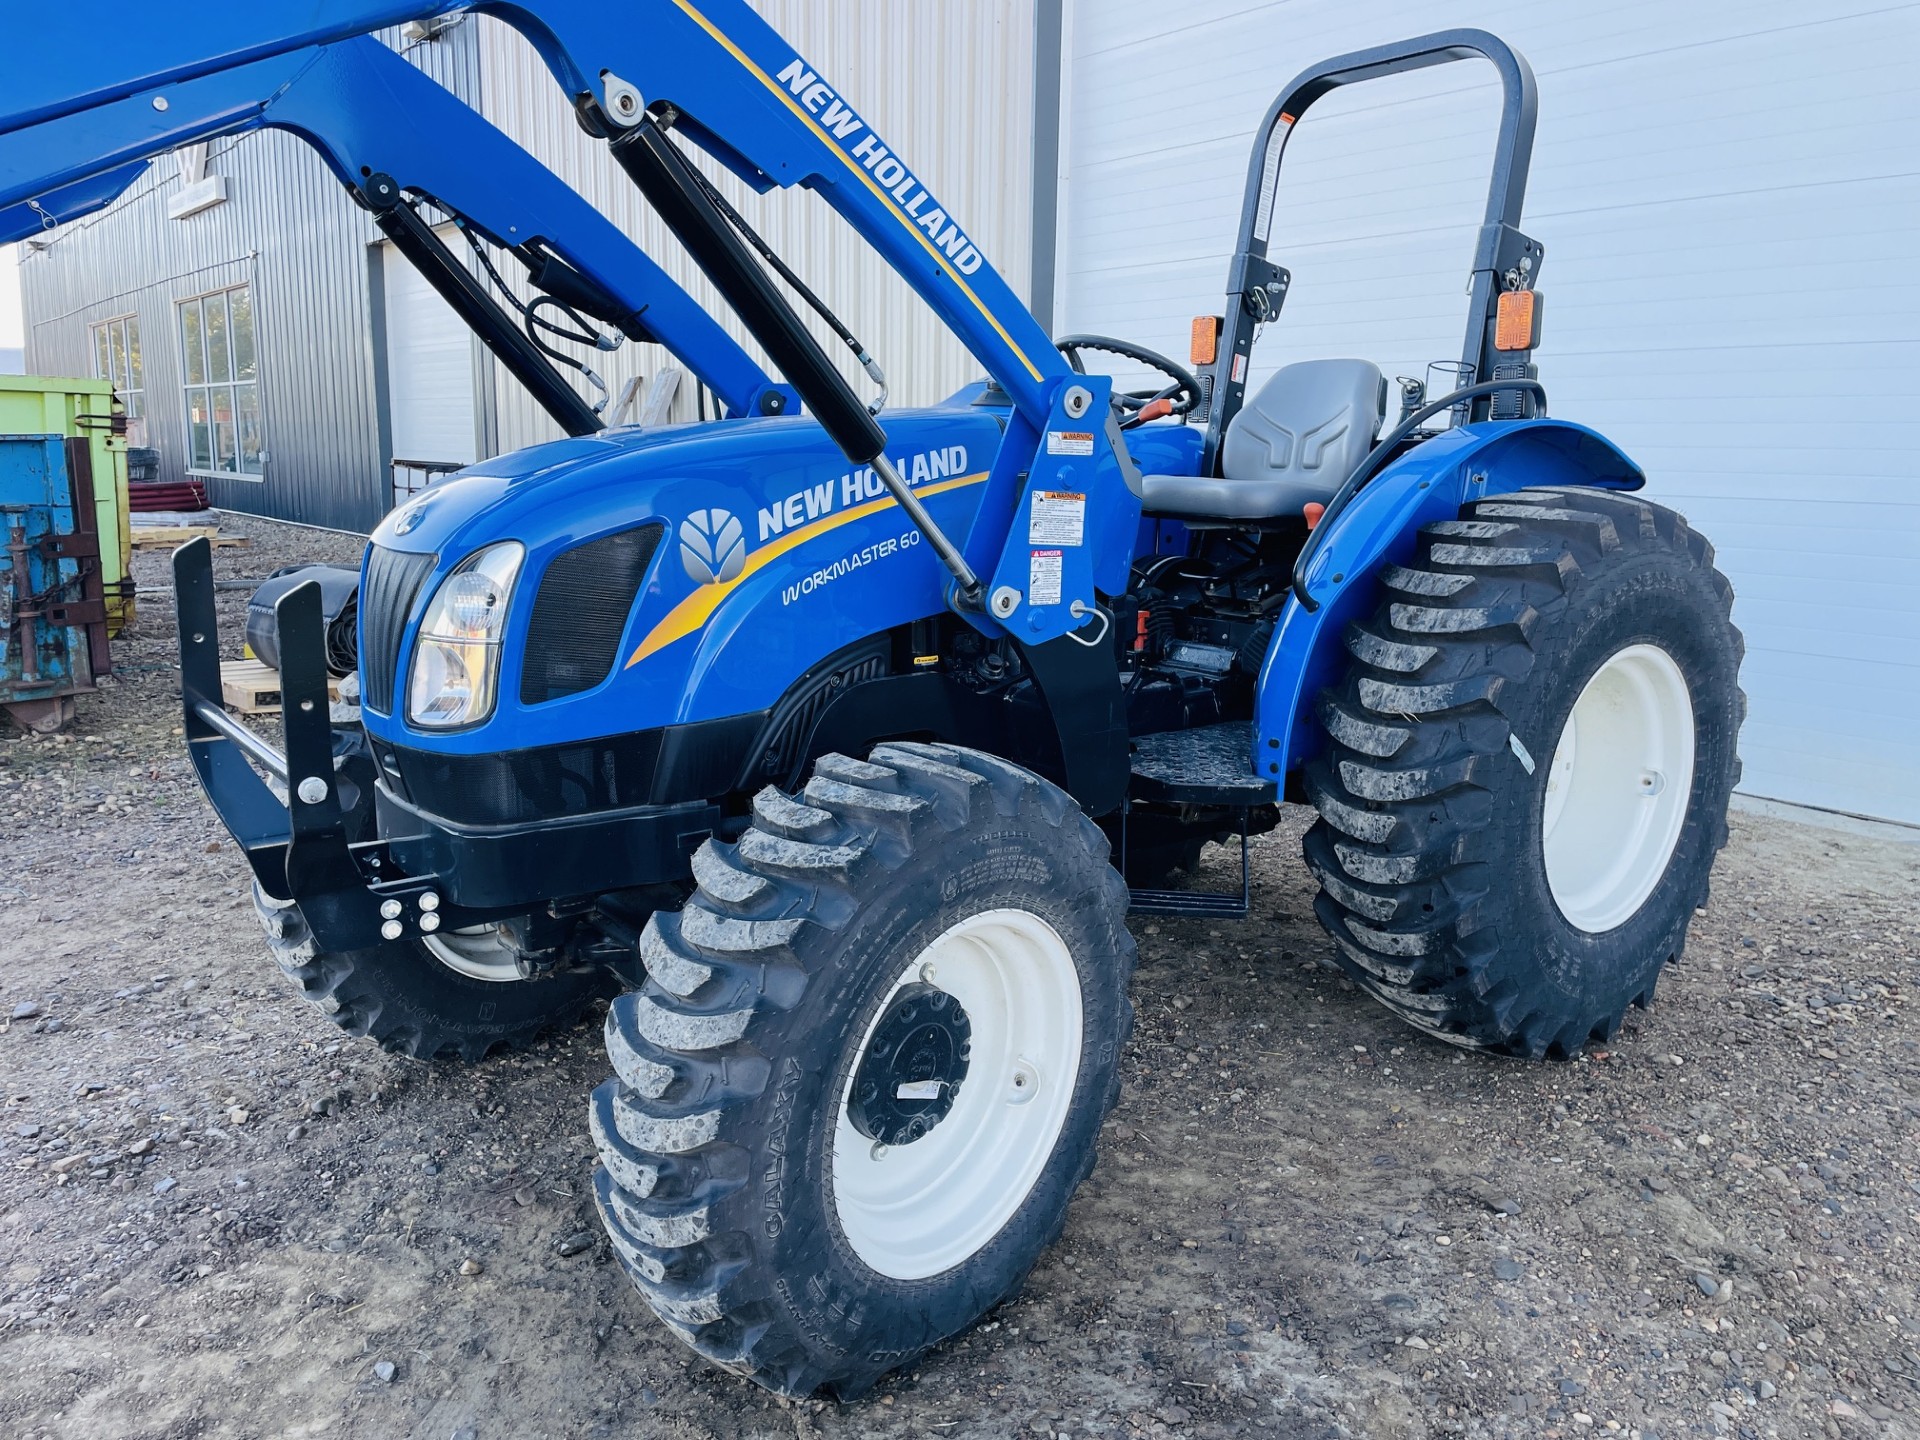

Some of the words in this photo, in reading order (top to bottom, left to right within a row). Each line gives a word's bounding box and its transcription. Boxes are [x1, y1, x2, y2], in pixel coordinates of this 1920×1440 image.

[776, 58, 864, 140] NEW
[851, 134, 983, 276] HOLLAND
[758, 479, 834, 542] NEW
[841, 445, 968, 507] HOLAND
[782, 538, 898, 606] WORKMASTER
[900, 530, 920, 549] 60
[764, 1056, 803, 1240] GALAXY
